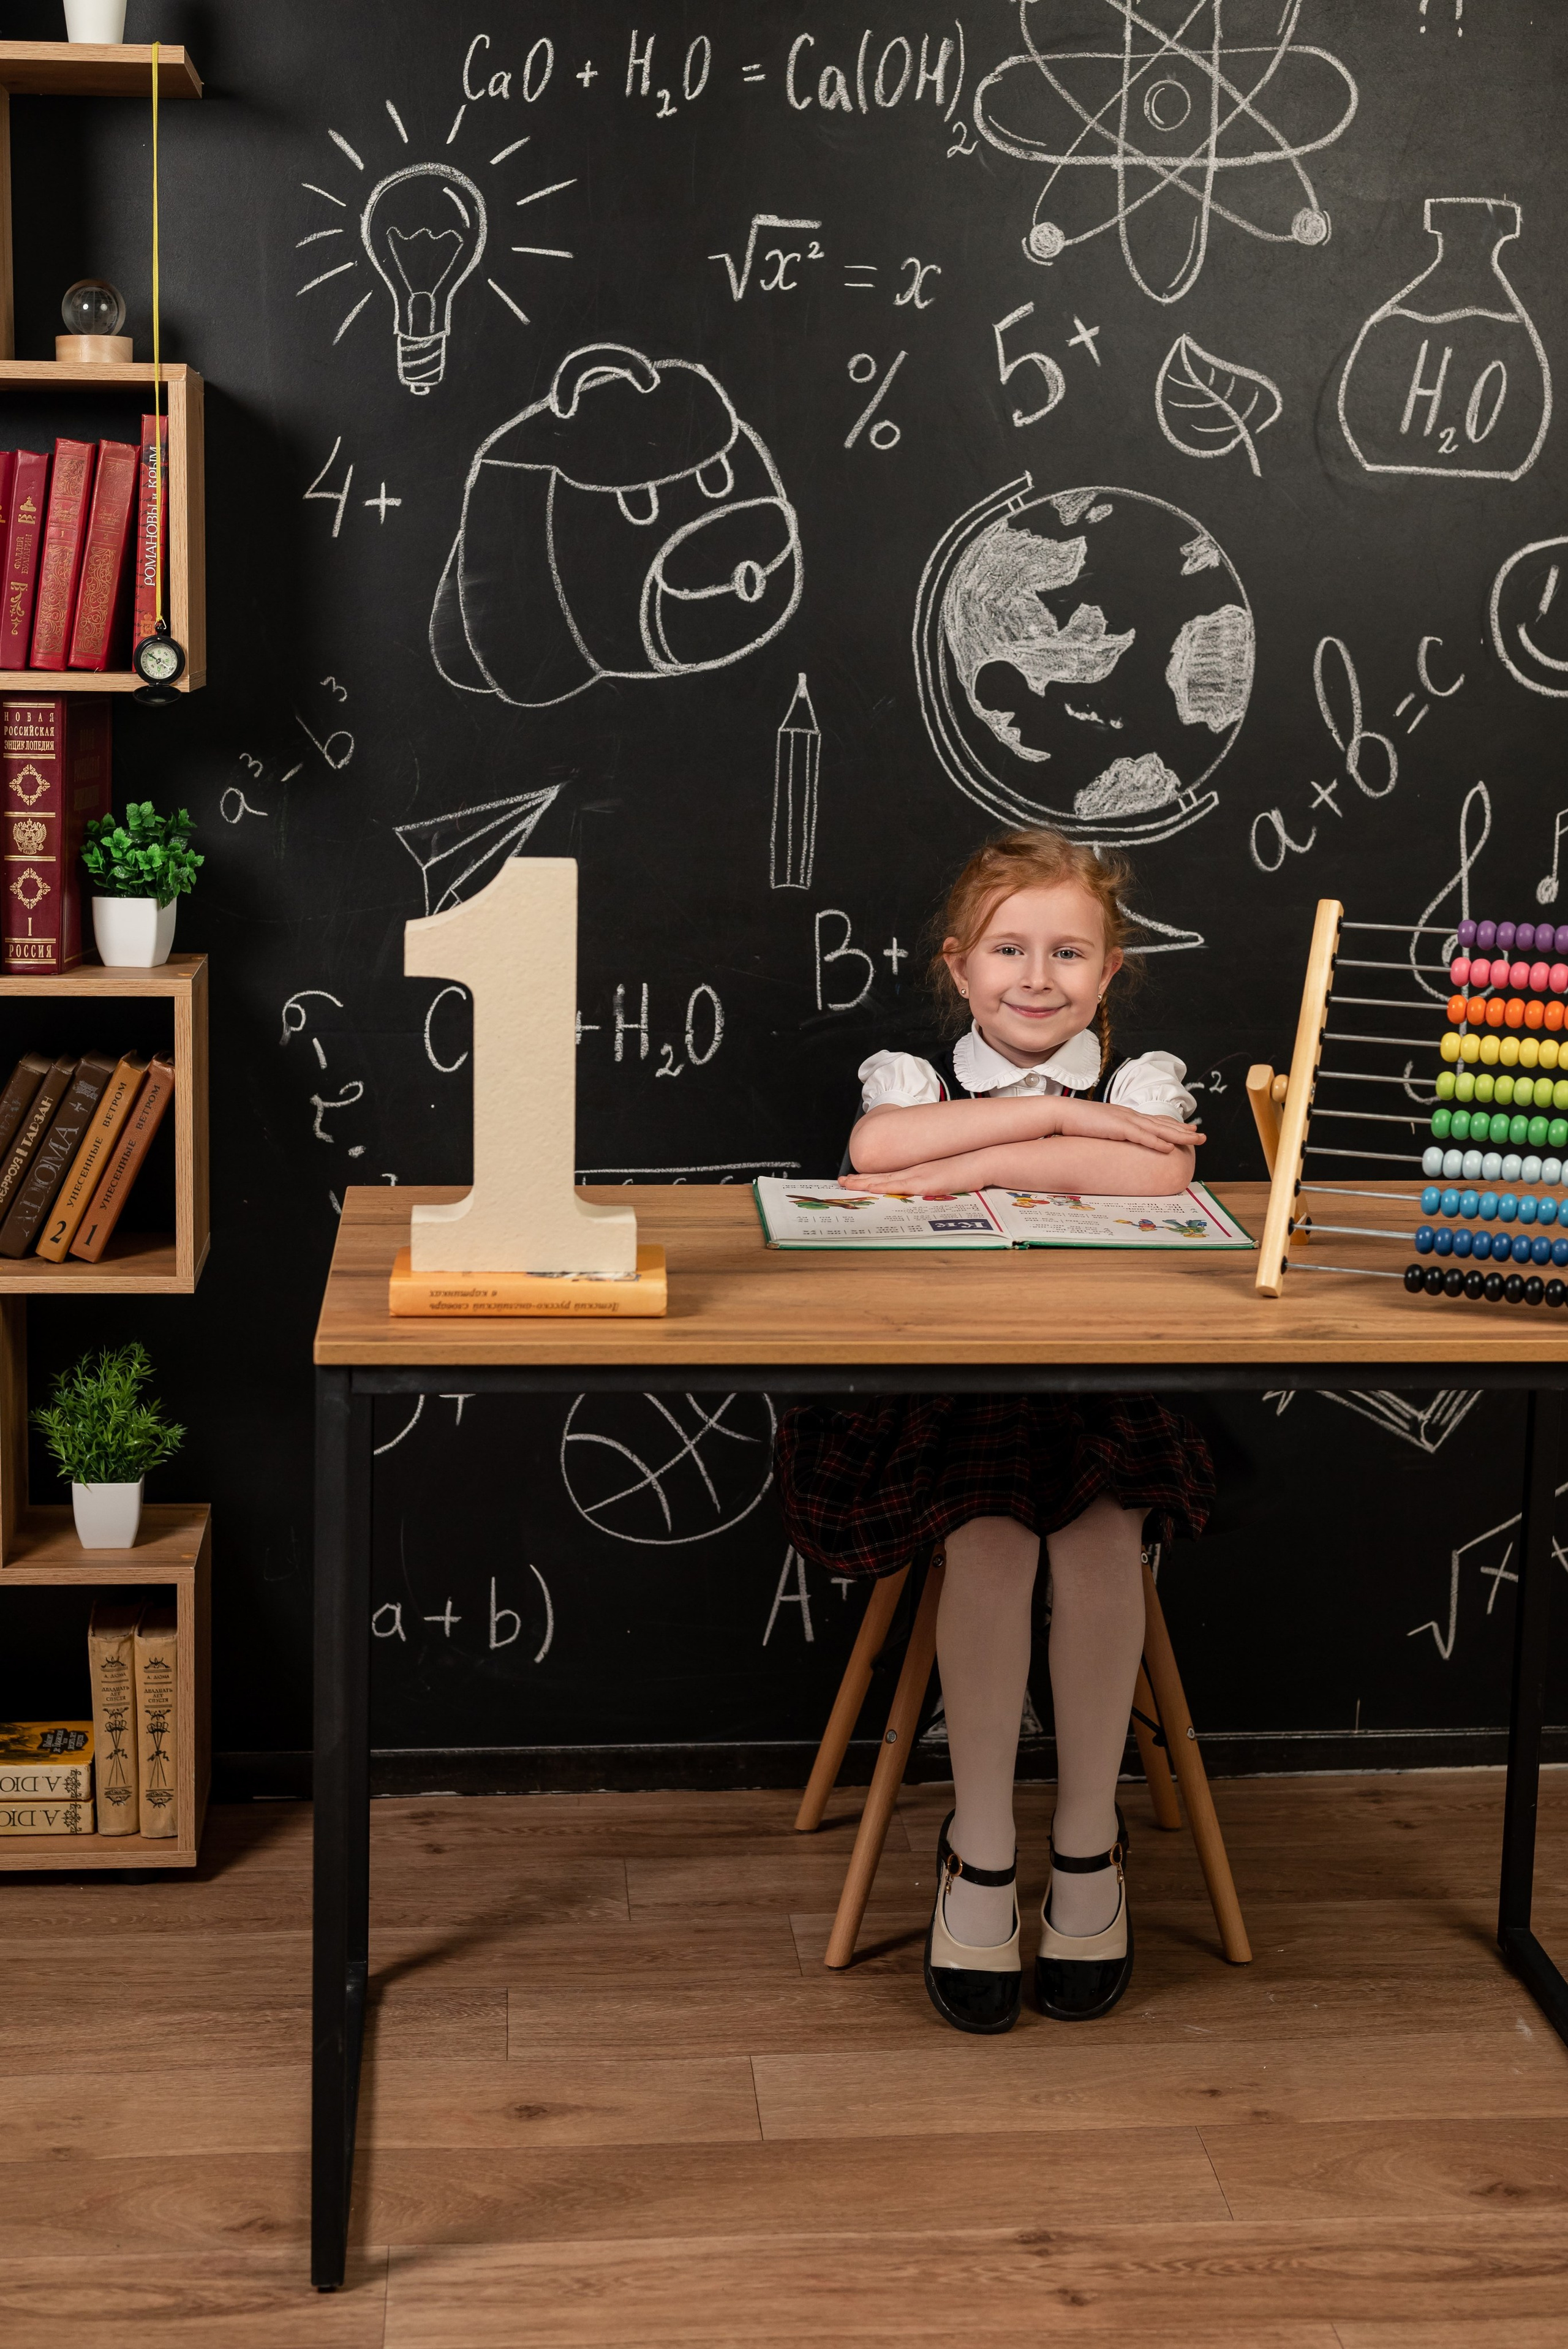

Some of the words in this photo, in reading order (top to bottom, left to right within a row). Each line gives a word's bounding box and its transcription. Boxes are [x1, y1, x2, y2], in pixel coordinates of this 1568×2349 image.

[463, 34, 554, 102] CaO
[894, 257, 941, 309] x
[843, 350, 909, 450] %
[14, 536, 24, 570] ФАДДЕЙ
[21, 534, 32, 575] БУЛГАРИН
[144, 503, 157, 587] РОМАНОВЫ
[4, 711, 55, 723] НОВАЯ
[4, 725, 55, 737] РОССИЙСКАЯ
[4, 740, 55, 752] ЭНЦИКЛОПЕДИЯ
[9, 944, 53, 959] РОССИЯ
[21, 1096, 54, 1147] ТАРЗАН
[67, 1136, 103, 1208] УНЕСЕННЫЕ
[102, 1082, 127, 1128] ВЕТРОМ
[99, 1139, 136, 1210] УНЕСЕННЫЕ
[136, 1084, 160, 1131] ВЕТРОМ
[50, 1220, 67, 1244] 2
[83, 1224, 98, 1246] 1
[424, 1597, 462, 1637] +
